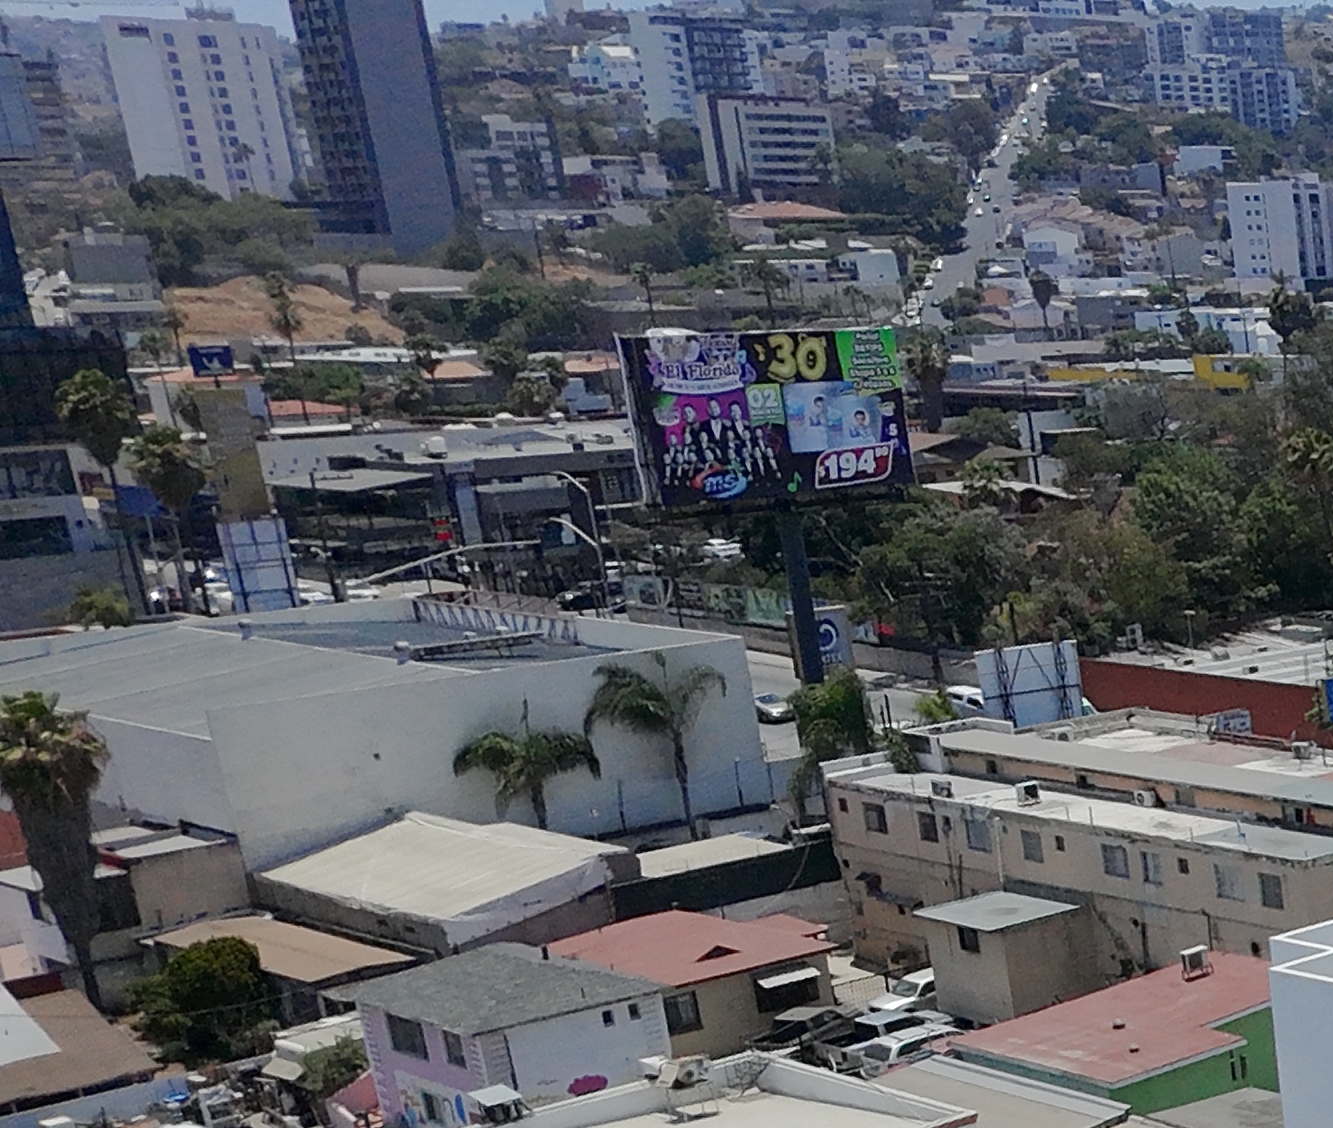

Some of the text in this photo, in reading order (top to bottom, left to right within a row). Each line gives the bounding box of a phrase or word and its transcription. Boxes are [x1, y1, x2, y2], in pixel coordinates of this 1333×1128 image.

[665, 364, 739, 378] El Florido
[748, 388, 779, 408] 02
